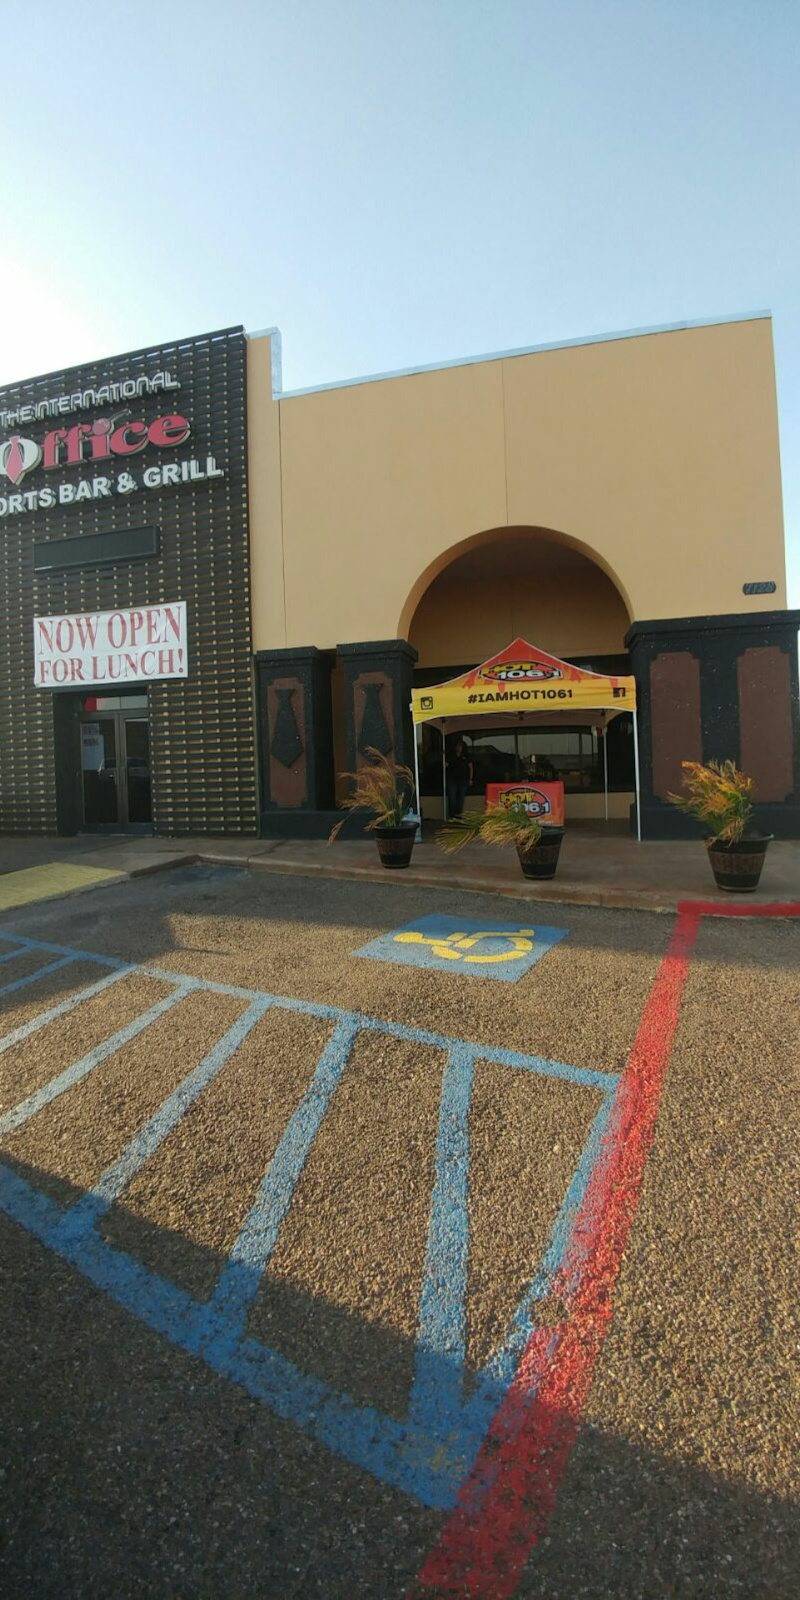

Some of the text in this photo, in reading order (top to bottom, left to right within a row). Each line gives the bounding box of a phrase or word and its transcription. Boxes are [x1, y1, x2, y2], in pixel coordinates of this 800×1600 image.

[0, 371, 180, 427] THE INTERNATIONAL
[0, 412, 190, 484] Office
[59, 477, 110, 504] BAR
[117, 472, 136, 494] &
[143, 456, 223, 488] GRILL
[38, 605, 182, 655] NOW OPEN
[39, 648, 184, 683] FOR LUNCH!
[481, 663, 536, 675] HOT
[468, 689, 573, 704] #IAMHOT1061
[500, 792, 535, 803] HOT
